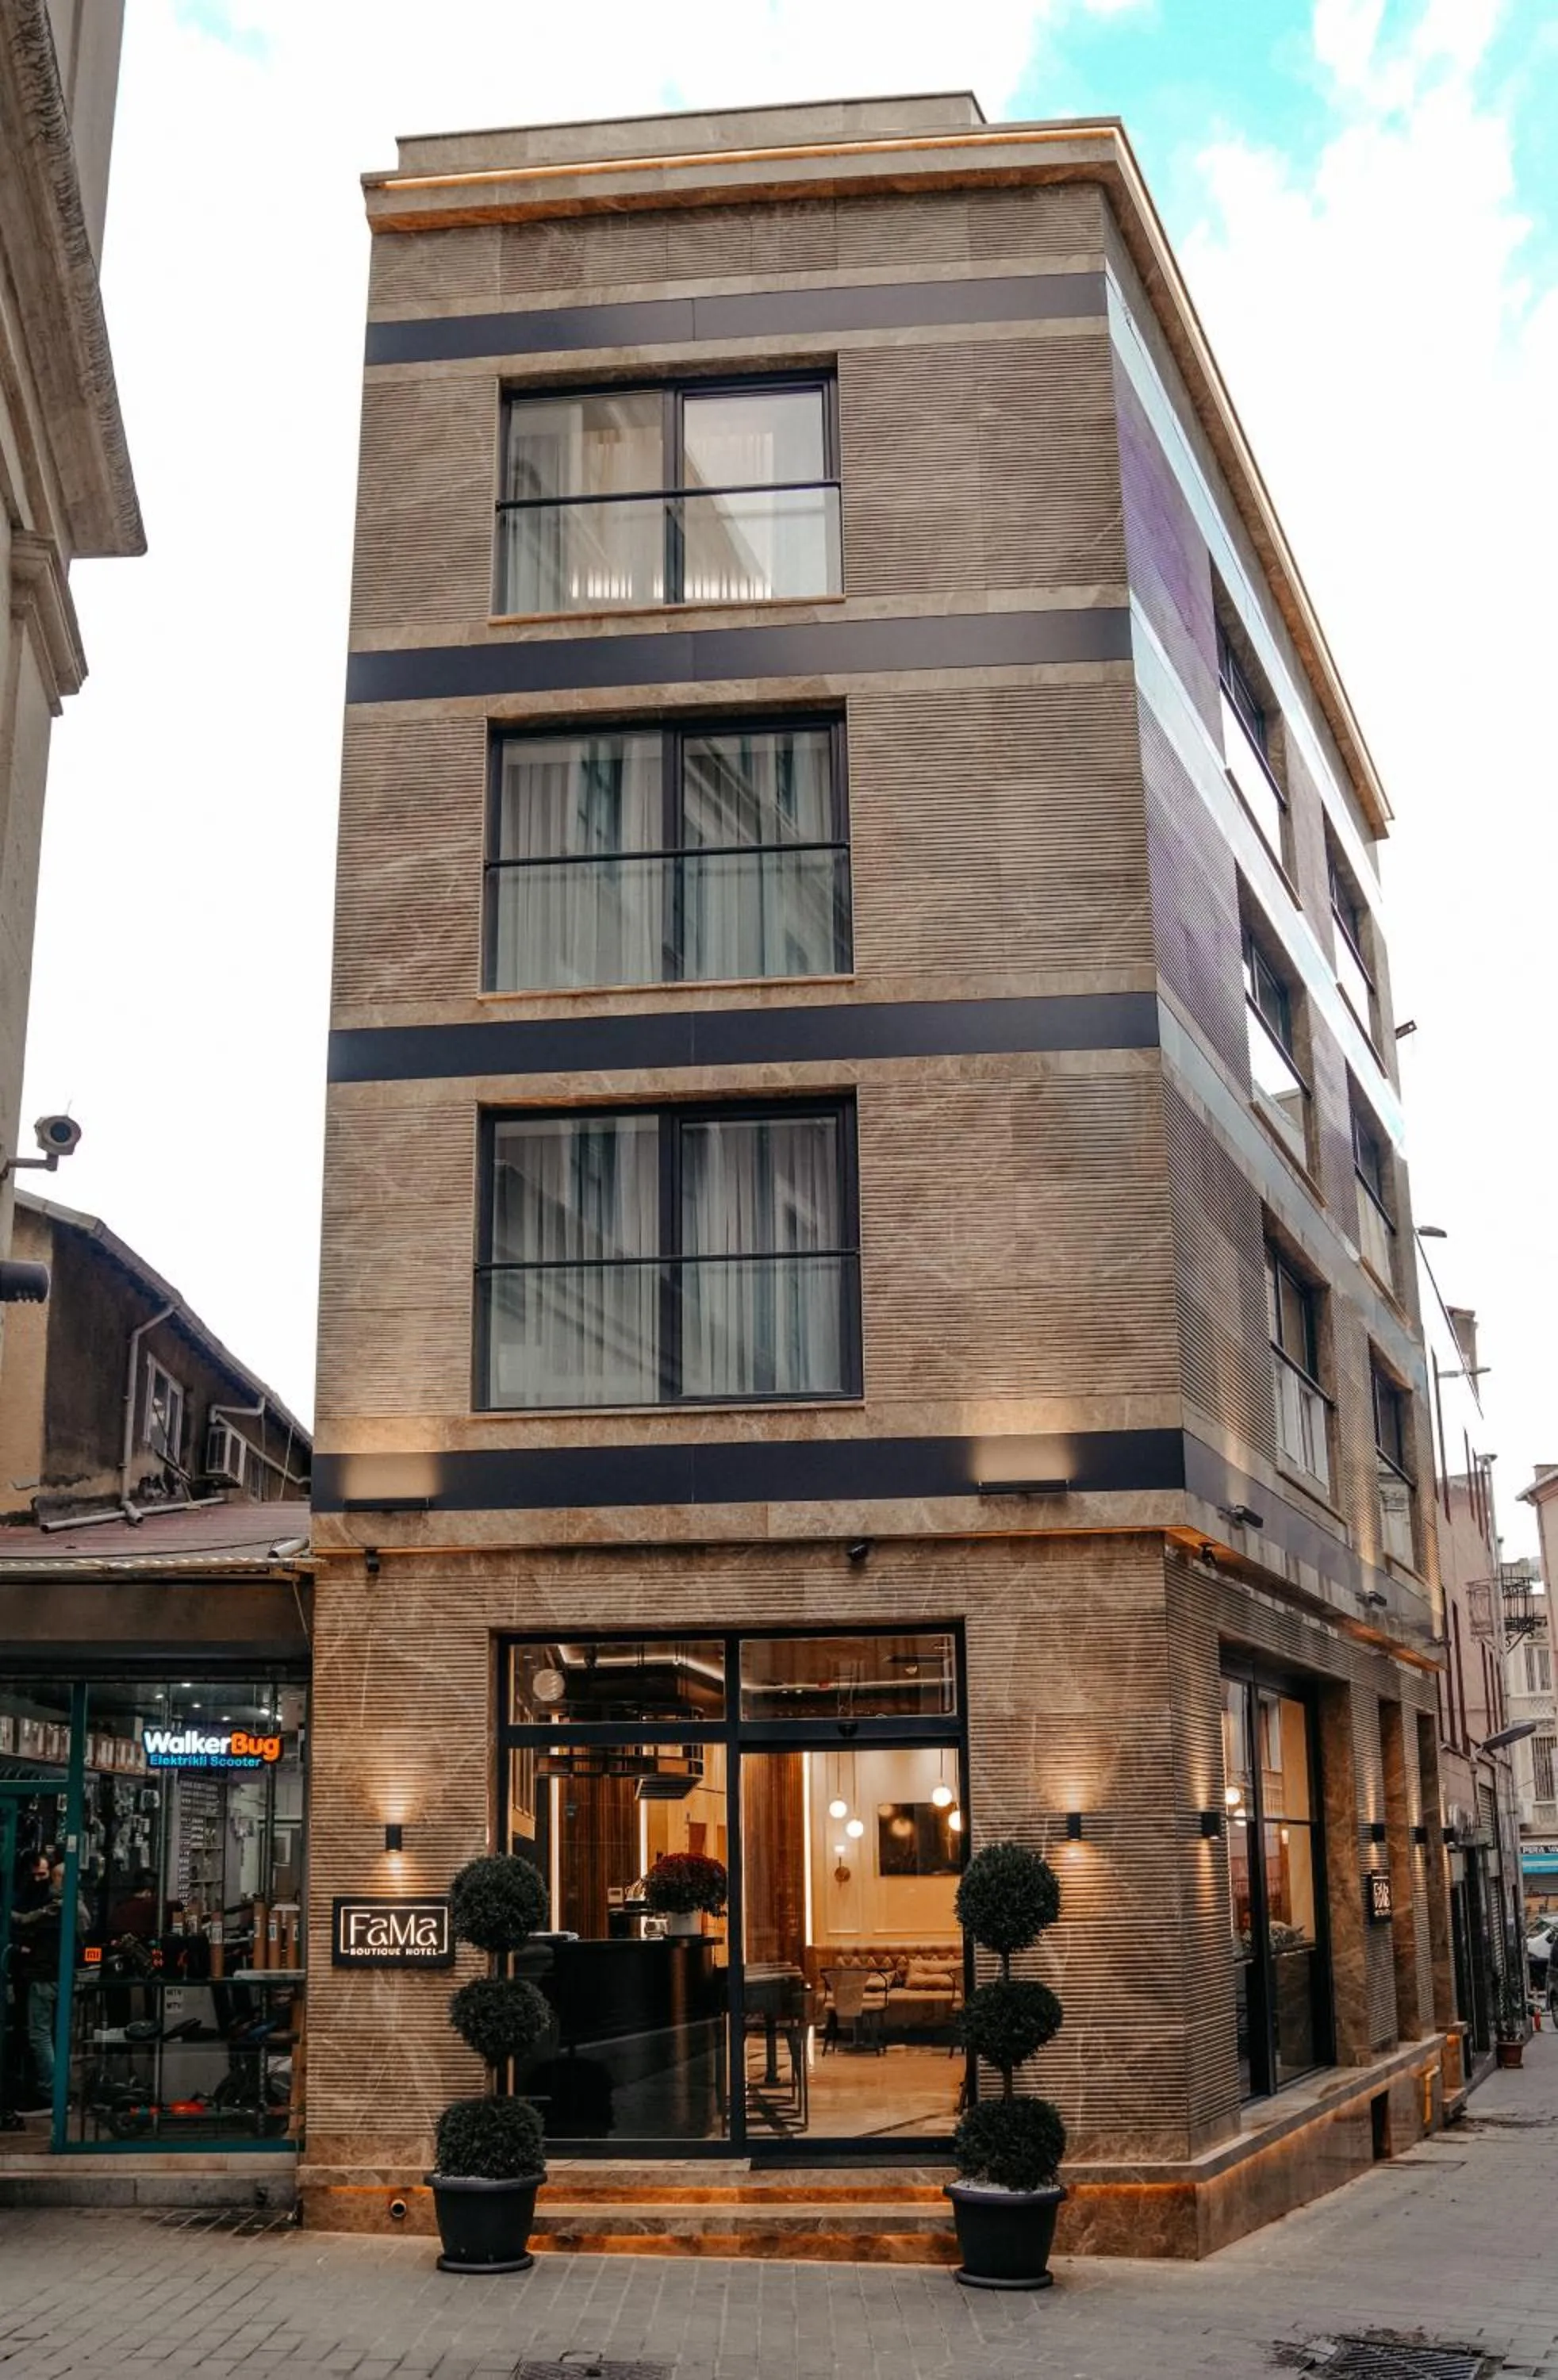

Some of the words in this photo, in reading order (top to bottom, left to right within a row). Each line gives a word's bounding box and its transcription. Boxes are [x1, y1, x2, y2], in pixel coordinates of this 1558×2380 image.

[144, 1729, 281, 1762] WalkerBug
[149, 1754, 208, 1766] Elektrikli
[210, 1755, 262, 1767] Scooter
[349, 1913, 439, 1947] FaMa
[349, 1947, 401, 1956] BOUTIQUE
[405, 1947, 438, 1956] HOTEL
